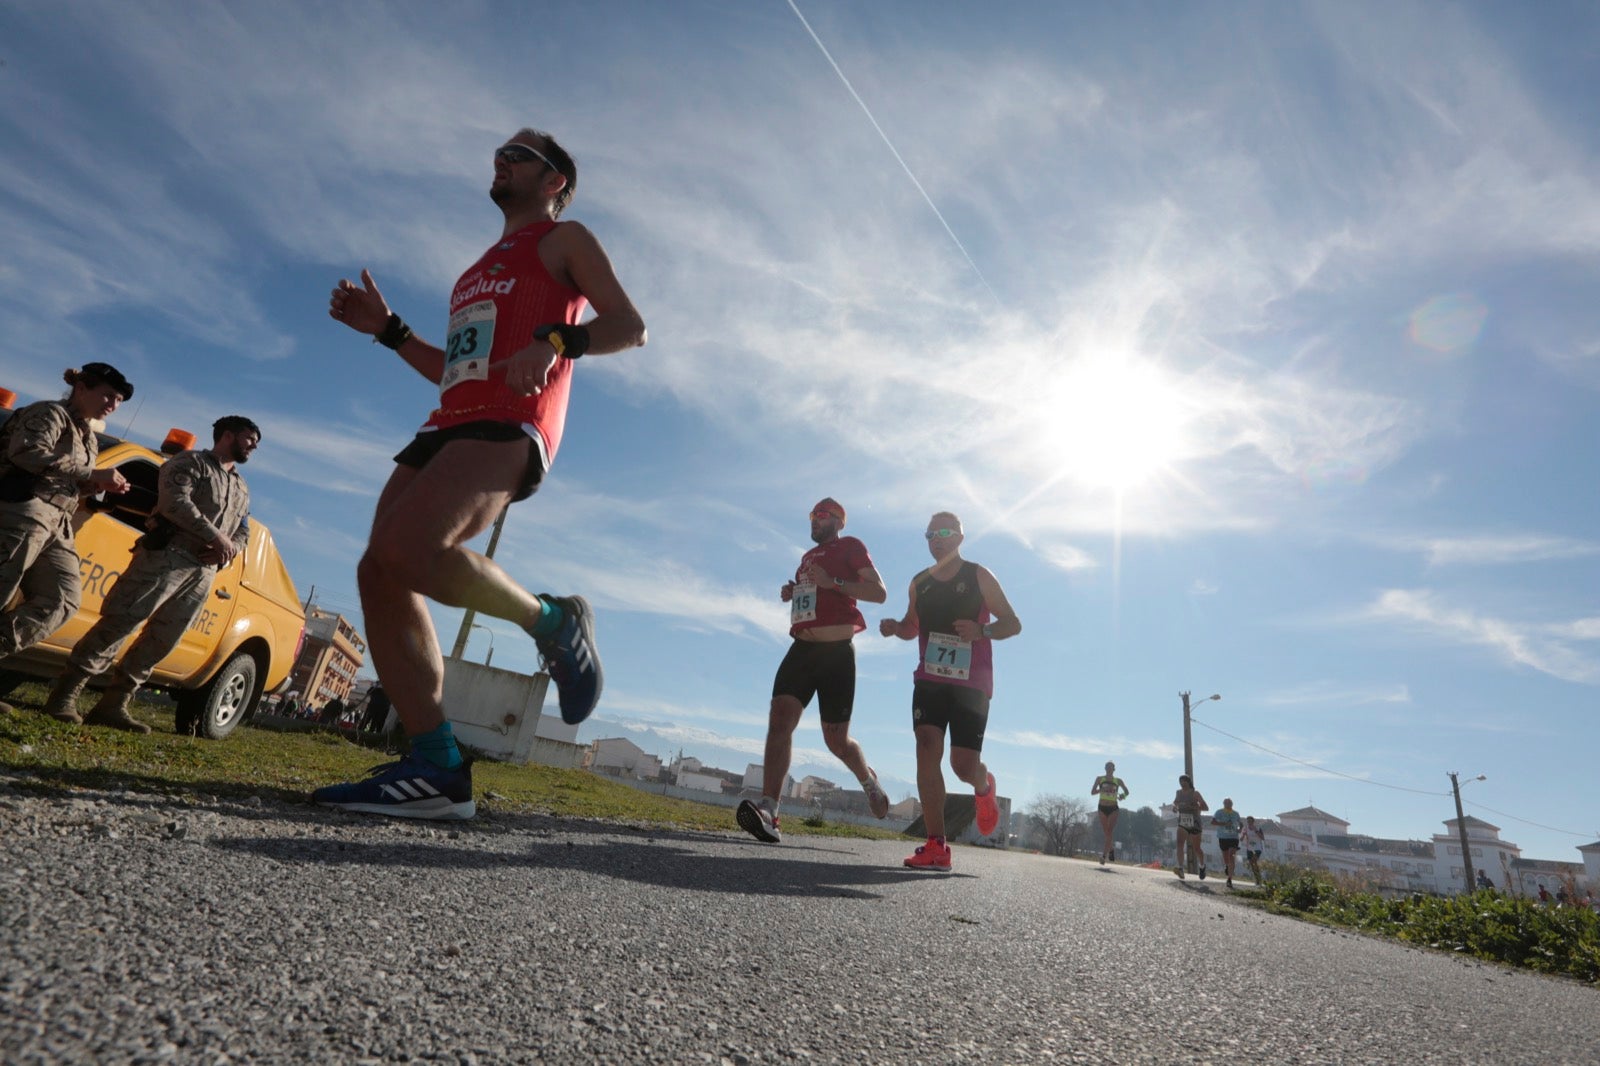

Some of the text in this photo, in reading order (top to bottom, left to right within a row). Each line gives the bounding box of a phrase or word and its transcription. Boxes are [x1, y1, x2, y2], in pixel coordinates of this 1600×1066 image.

[447, 327, 478, 364] 23
[793, 595, 810, 611] 15
[937, 647, 956, 665] 71
